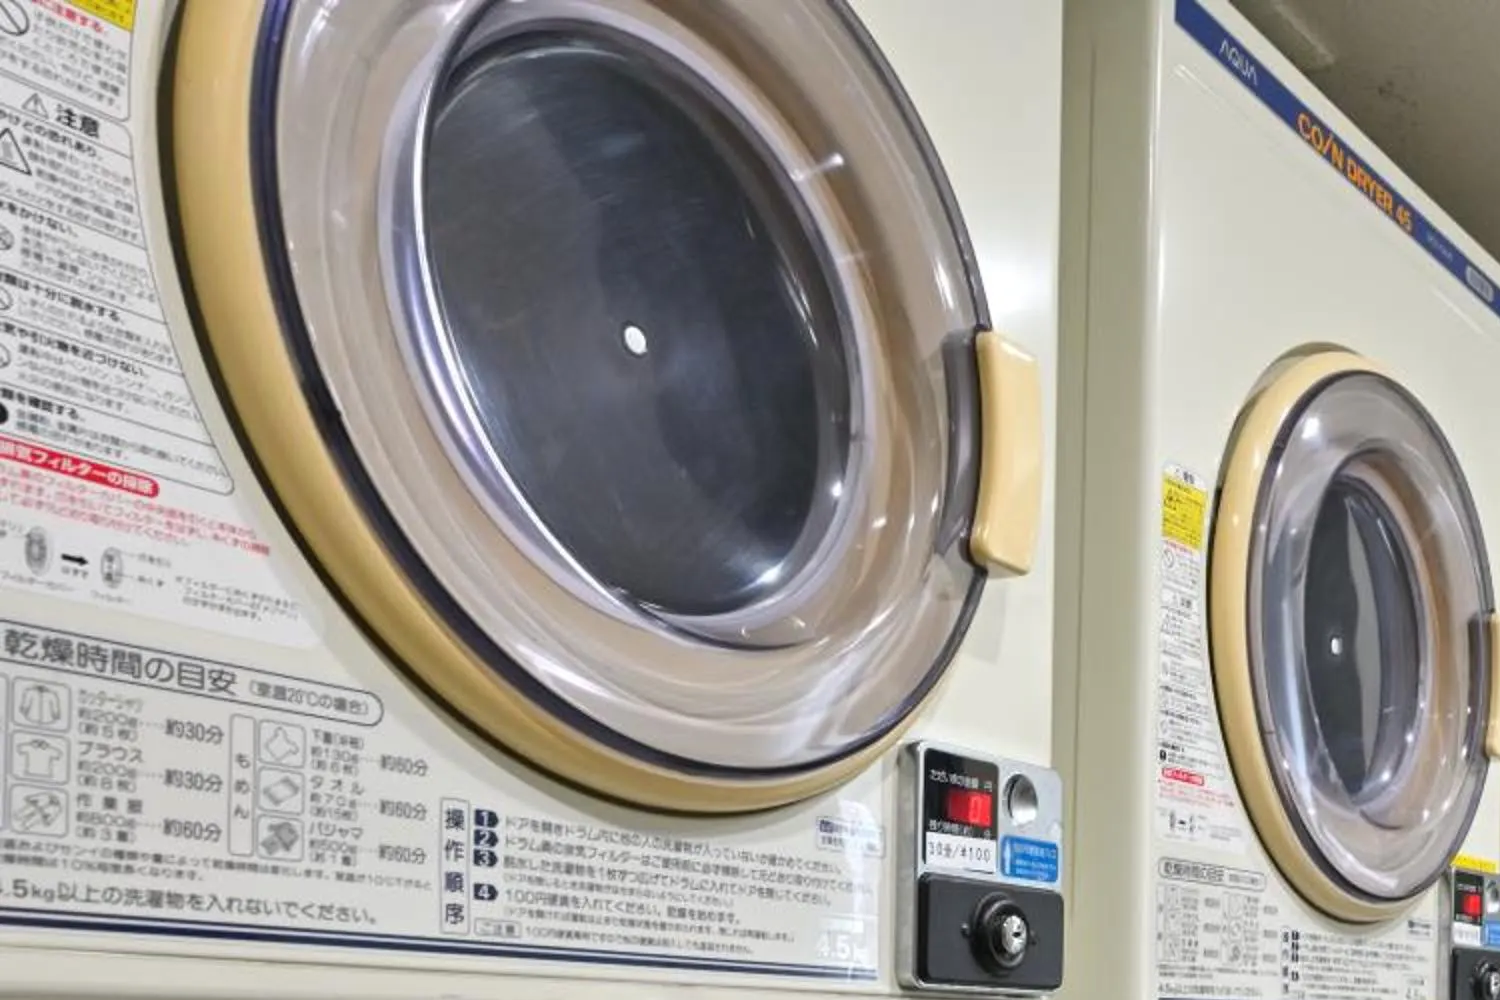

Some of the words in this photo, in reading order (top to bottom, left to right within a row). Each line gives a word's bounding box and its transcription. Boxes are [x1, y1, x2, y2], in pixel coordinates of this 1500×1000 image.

[56, 103, 99, 139] 注意
[4, 629, 237, 697] 乾燥時間の目安
[77, 740, 144, 763] ブラウス
[479, 830, 490, 846] 2
[479, 850, 490, 866] 3
[478, 884, 490, 900] 4
